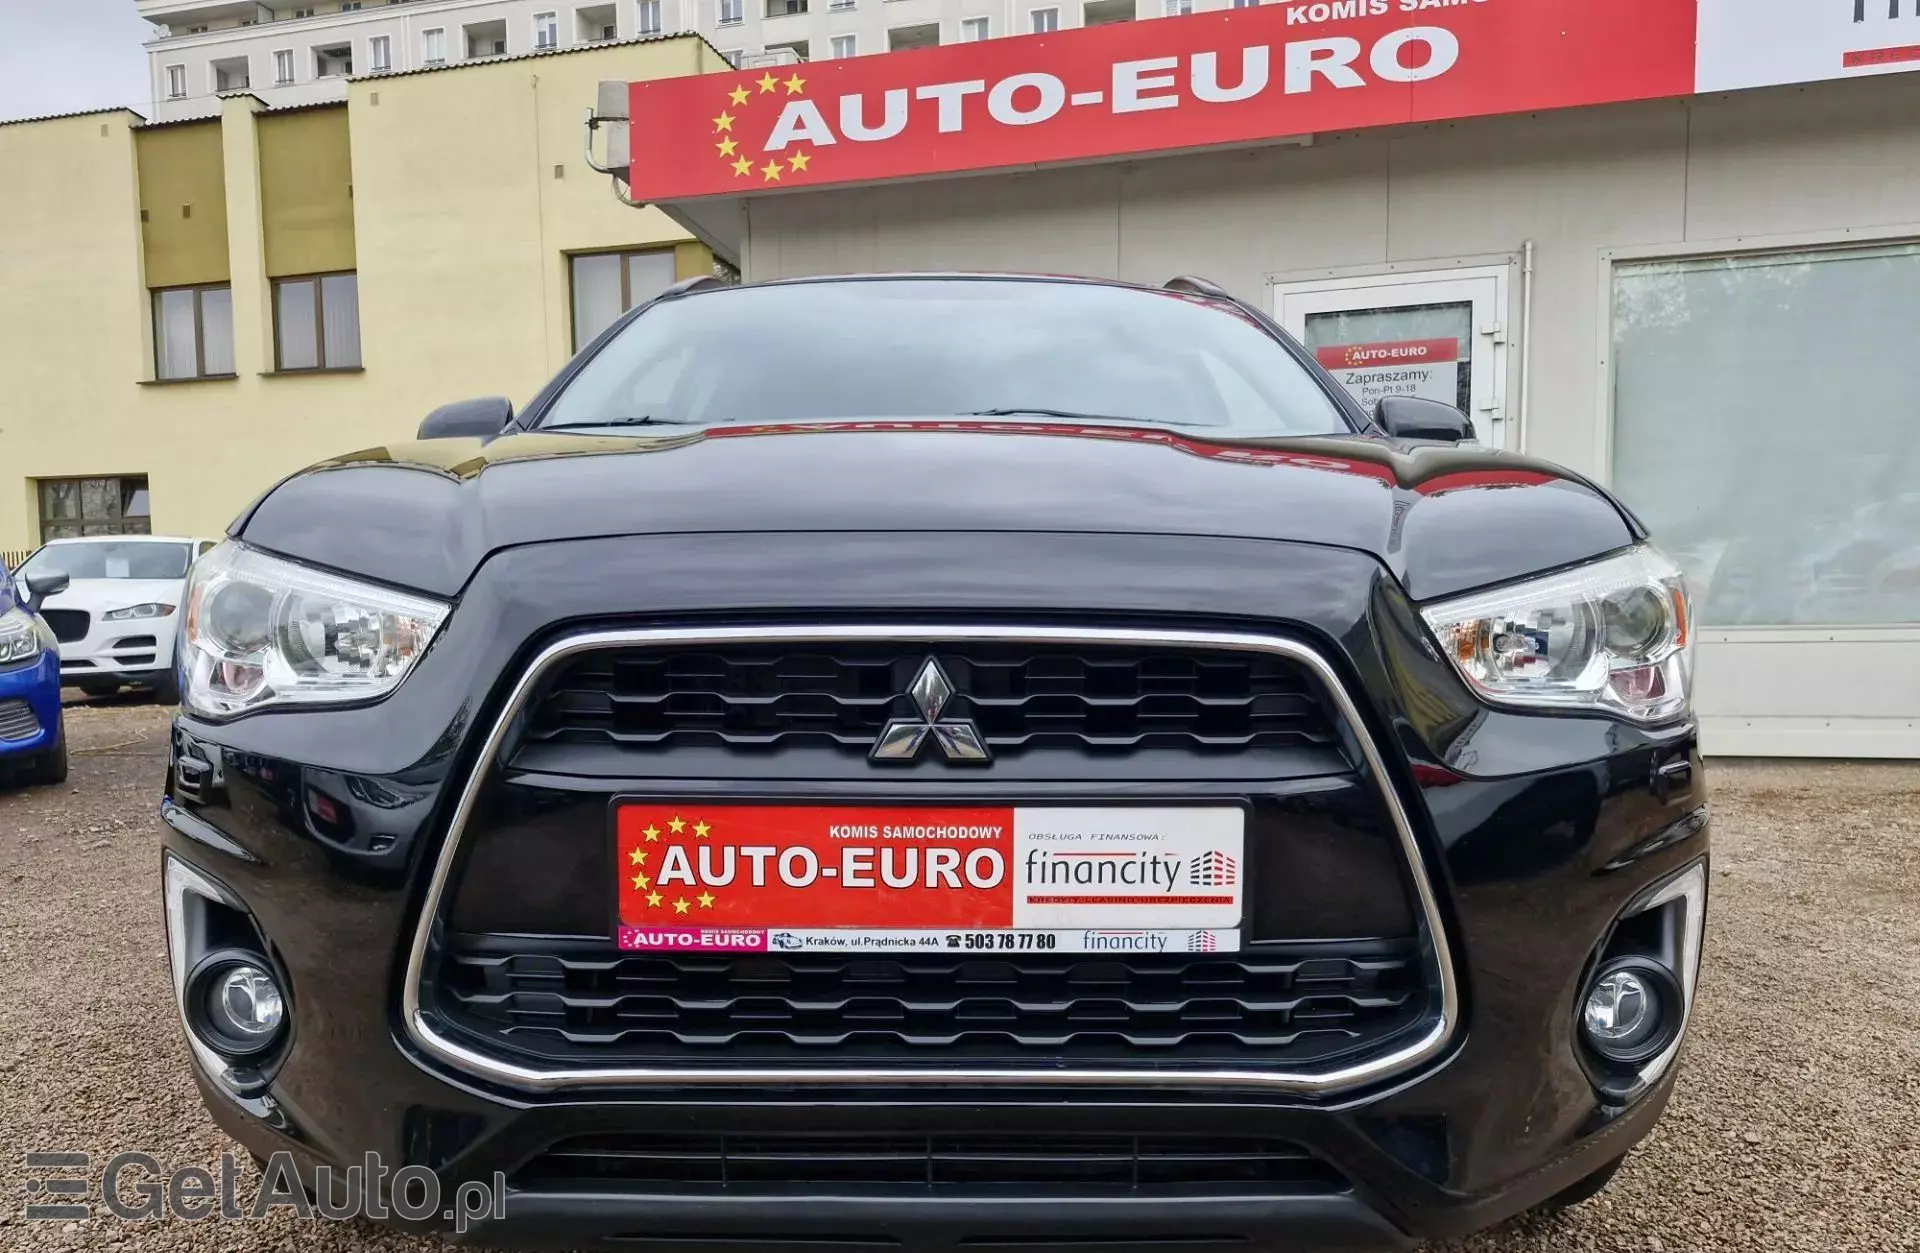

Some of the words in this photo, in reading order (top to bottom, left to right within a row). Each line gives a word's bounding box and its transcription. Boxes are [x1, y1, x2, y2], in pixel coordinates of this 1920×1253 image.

[1286, 0, 1388, 25] KOMIS
[763, 26, 1459, 151] AUTO-EURO
[1352, 346, 1427, 360] AUTO-EURO
[1345, 370, 1433, 386] Zapraszamy:
[1362, 385, 1393, 395] Pon-Pt
[1395, 384, 1416, 394] 9-18
[829, 825, 878, 839] KOMIS
[882, 826, 1003, 839] SAMOCHODOWY
[1028, 833, 1082, 841] OBSŁUGA
[1090, 833, 1167, 841] FINANSOWA:
[655, 845, 1006, 889] AUTO-EURO
[1025, 849, 1181, 892] financity
[633, 933, 761, 947] AUTO-EURO
[805, 936, 848, 947] Kraków,
[918, 937, 939, 946] 44A
[965, 934, 994, 949] 503
[997, 934, 1014, 949] 78
[1018, 934, 1033, 949] 77
[1036, 934, 1056, 949] 80
[1083, 929, 1168, 953] financity
